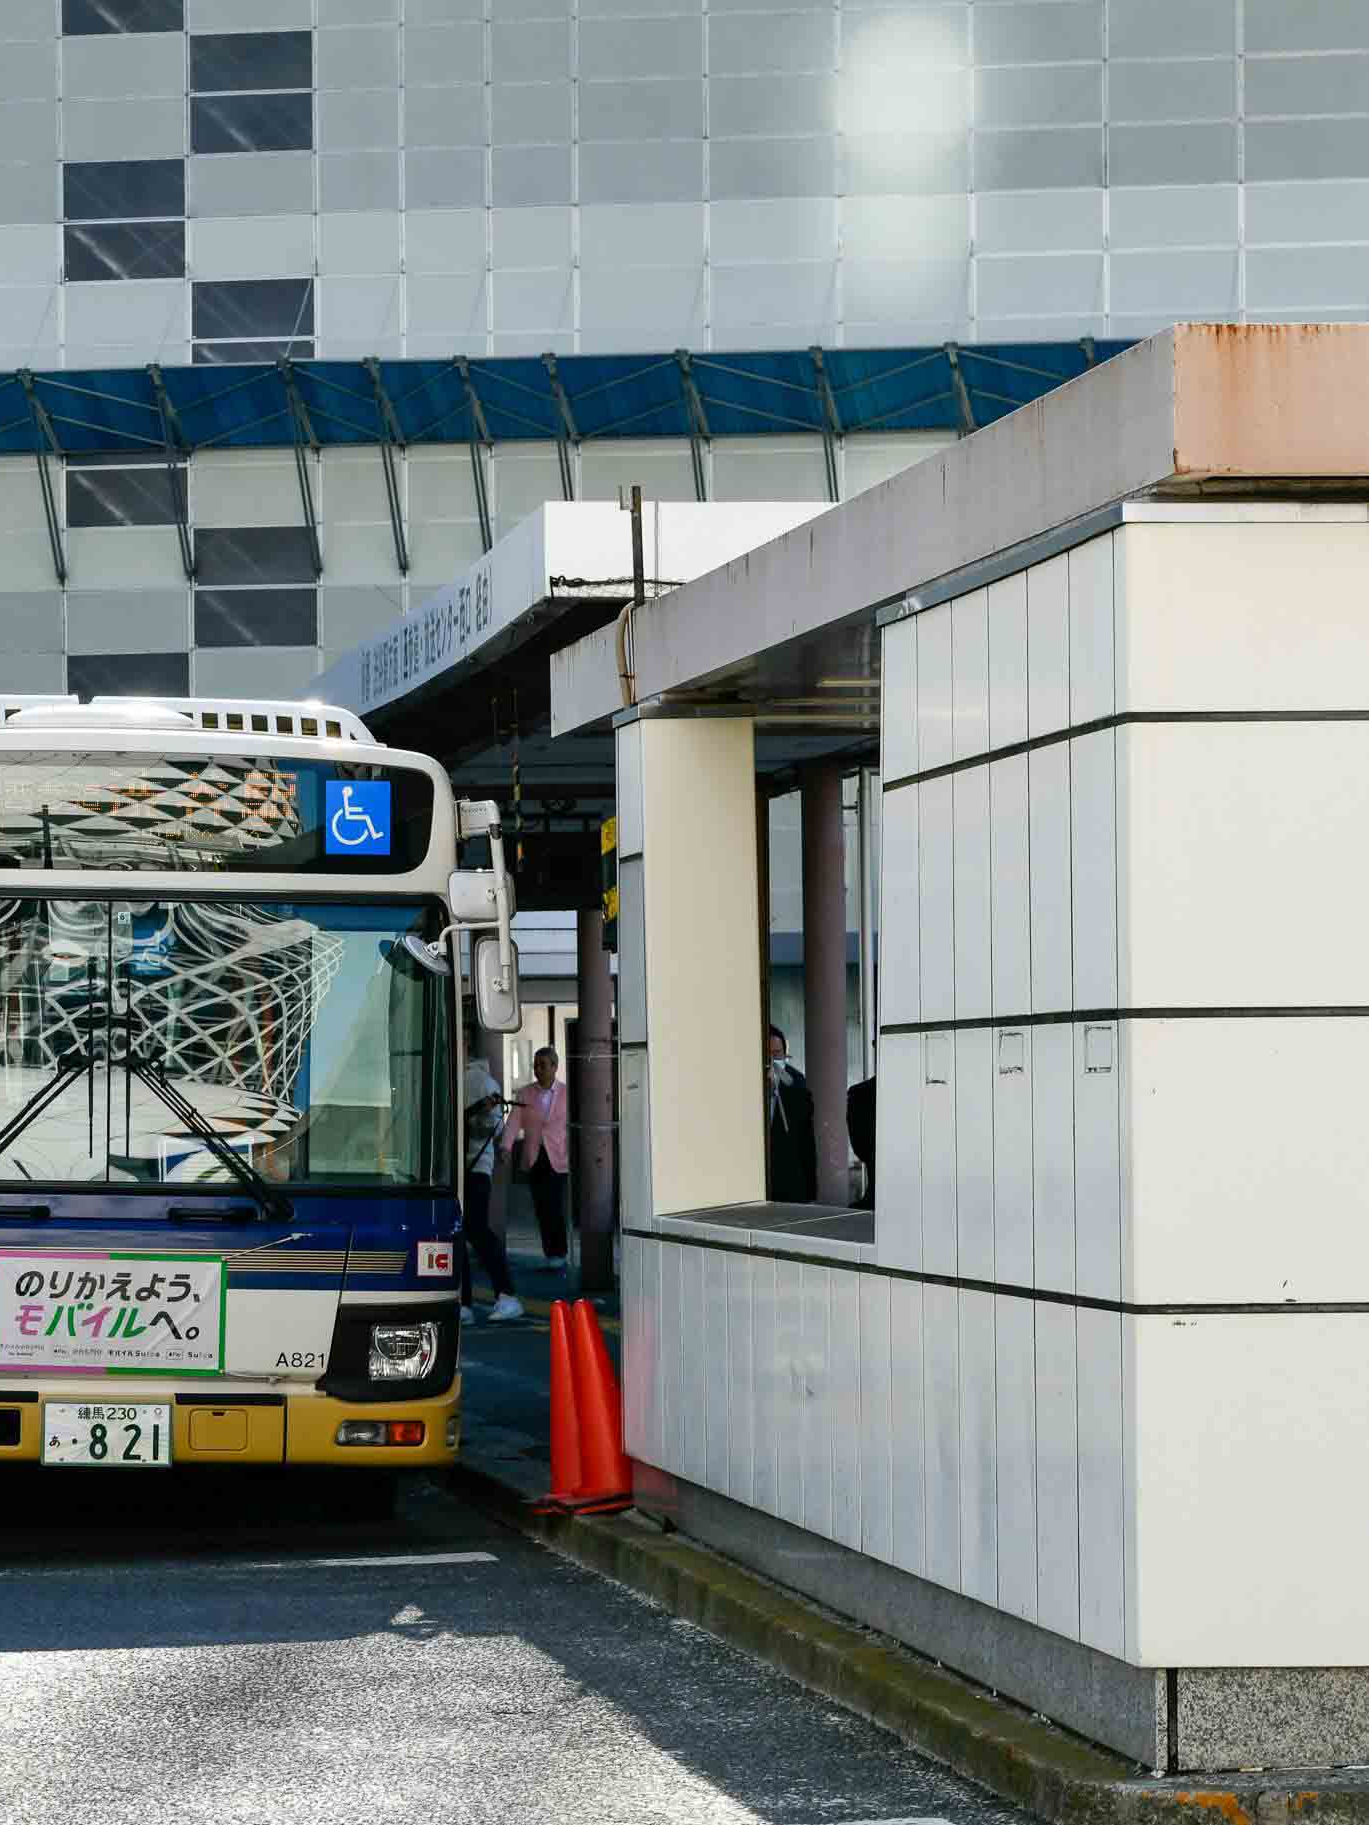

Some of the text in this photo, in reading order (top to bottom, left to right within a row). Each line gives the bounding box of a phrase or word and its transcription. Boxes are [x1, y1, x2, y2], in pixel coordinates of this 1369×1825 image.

[14, 1270, 201, 1303] のりかえよう、
[14, 1303, 200, 1341] モバイルへ。
[275, 1352, 325, 1368] A821
